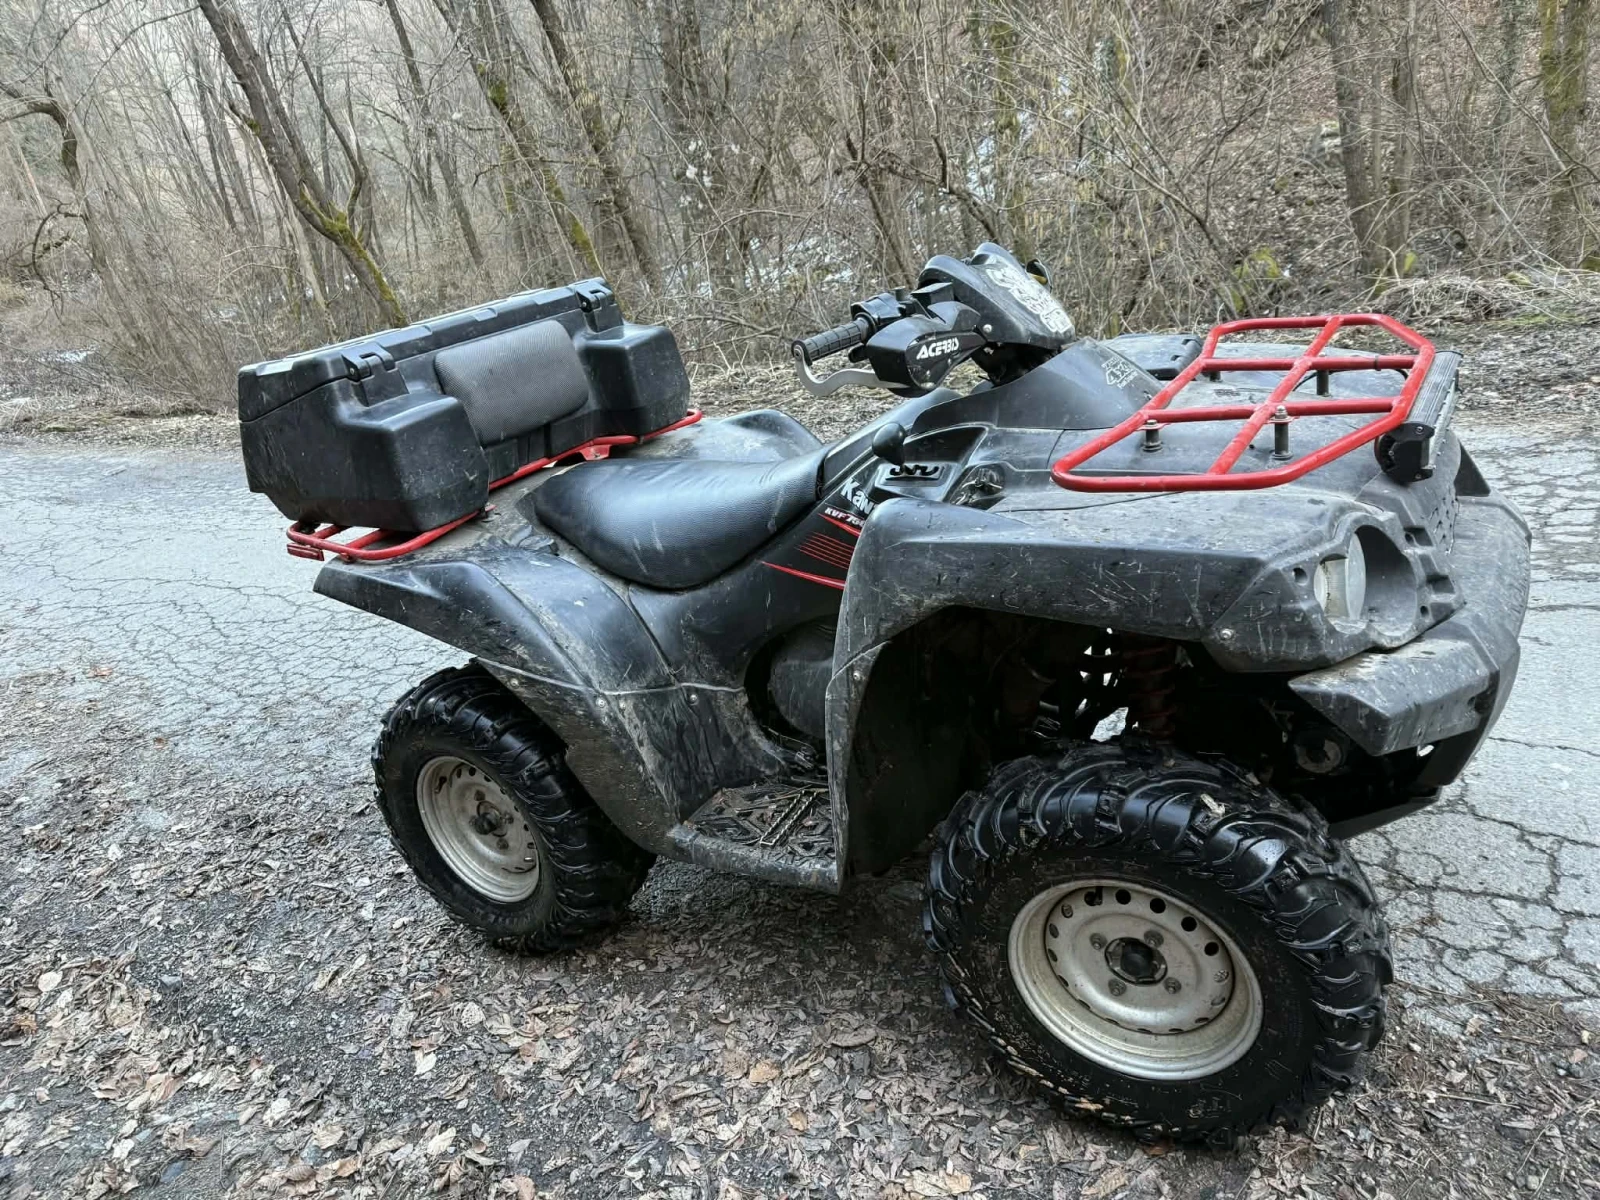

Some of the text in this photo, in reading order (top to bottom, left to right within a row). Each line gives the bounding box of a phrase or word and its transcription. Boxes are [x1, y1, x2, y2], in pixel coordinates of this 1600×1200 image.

[916, 337, 959, 360] ACERBIS
[841, 477, 875, 514] Kaw
[825, 507, 847, 519] KVF
